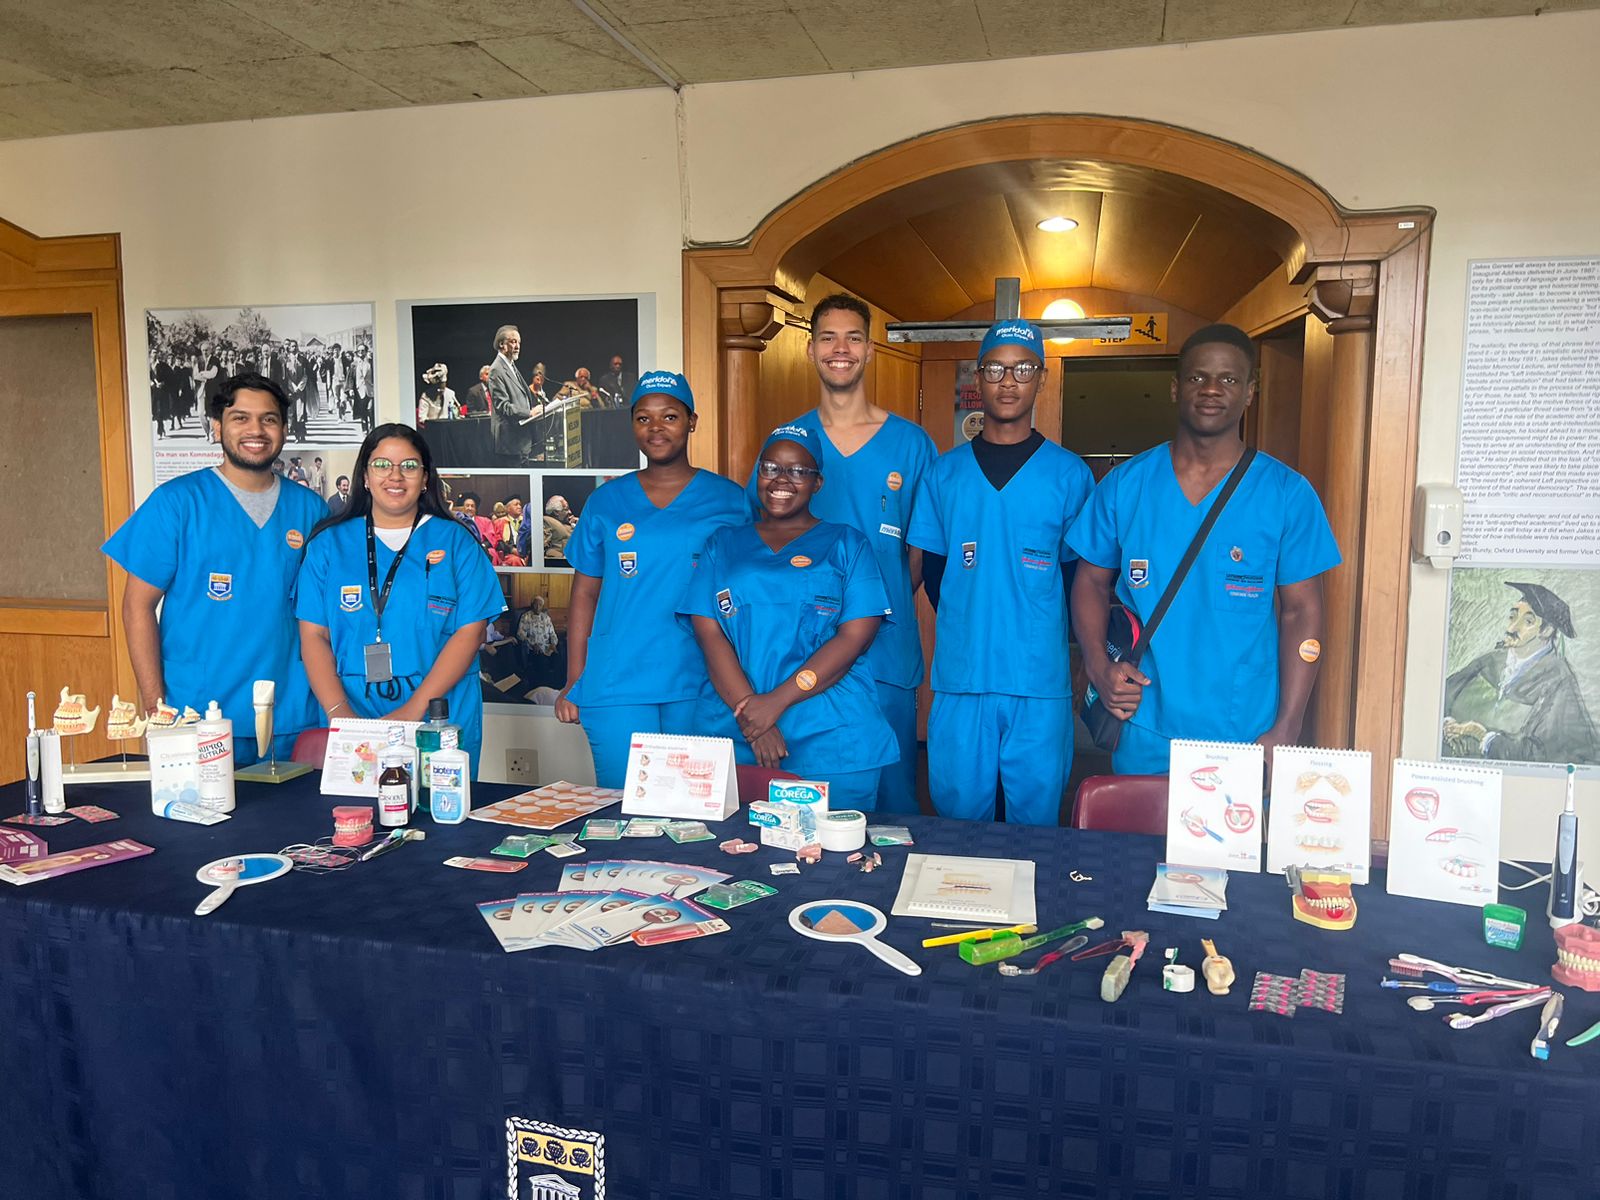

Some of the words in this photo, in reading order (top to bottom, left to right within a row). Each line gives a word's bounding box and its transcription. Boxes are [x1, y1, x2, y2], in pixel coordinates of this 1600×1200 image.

[190, 451, 225, 459] Kommadagg
[774, 788, 814, 800] COREGA
[754, 812, 776, 823] COREGA
